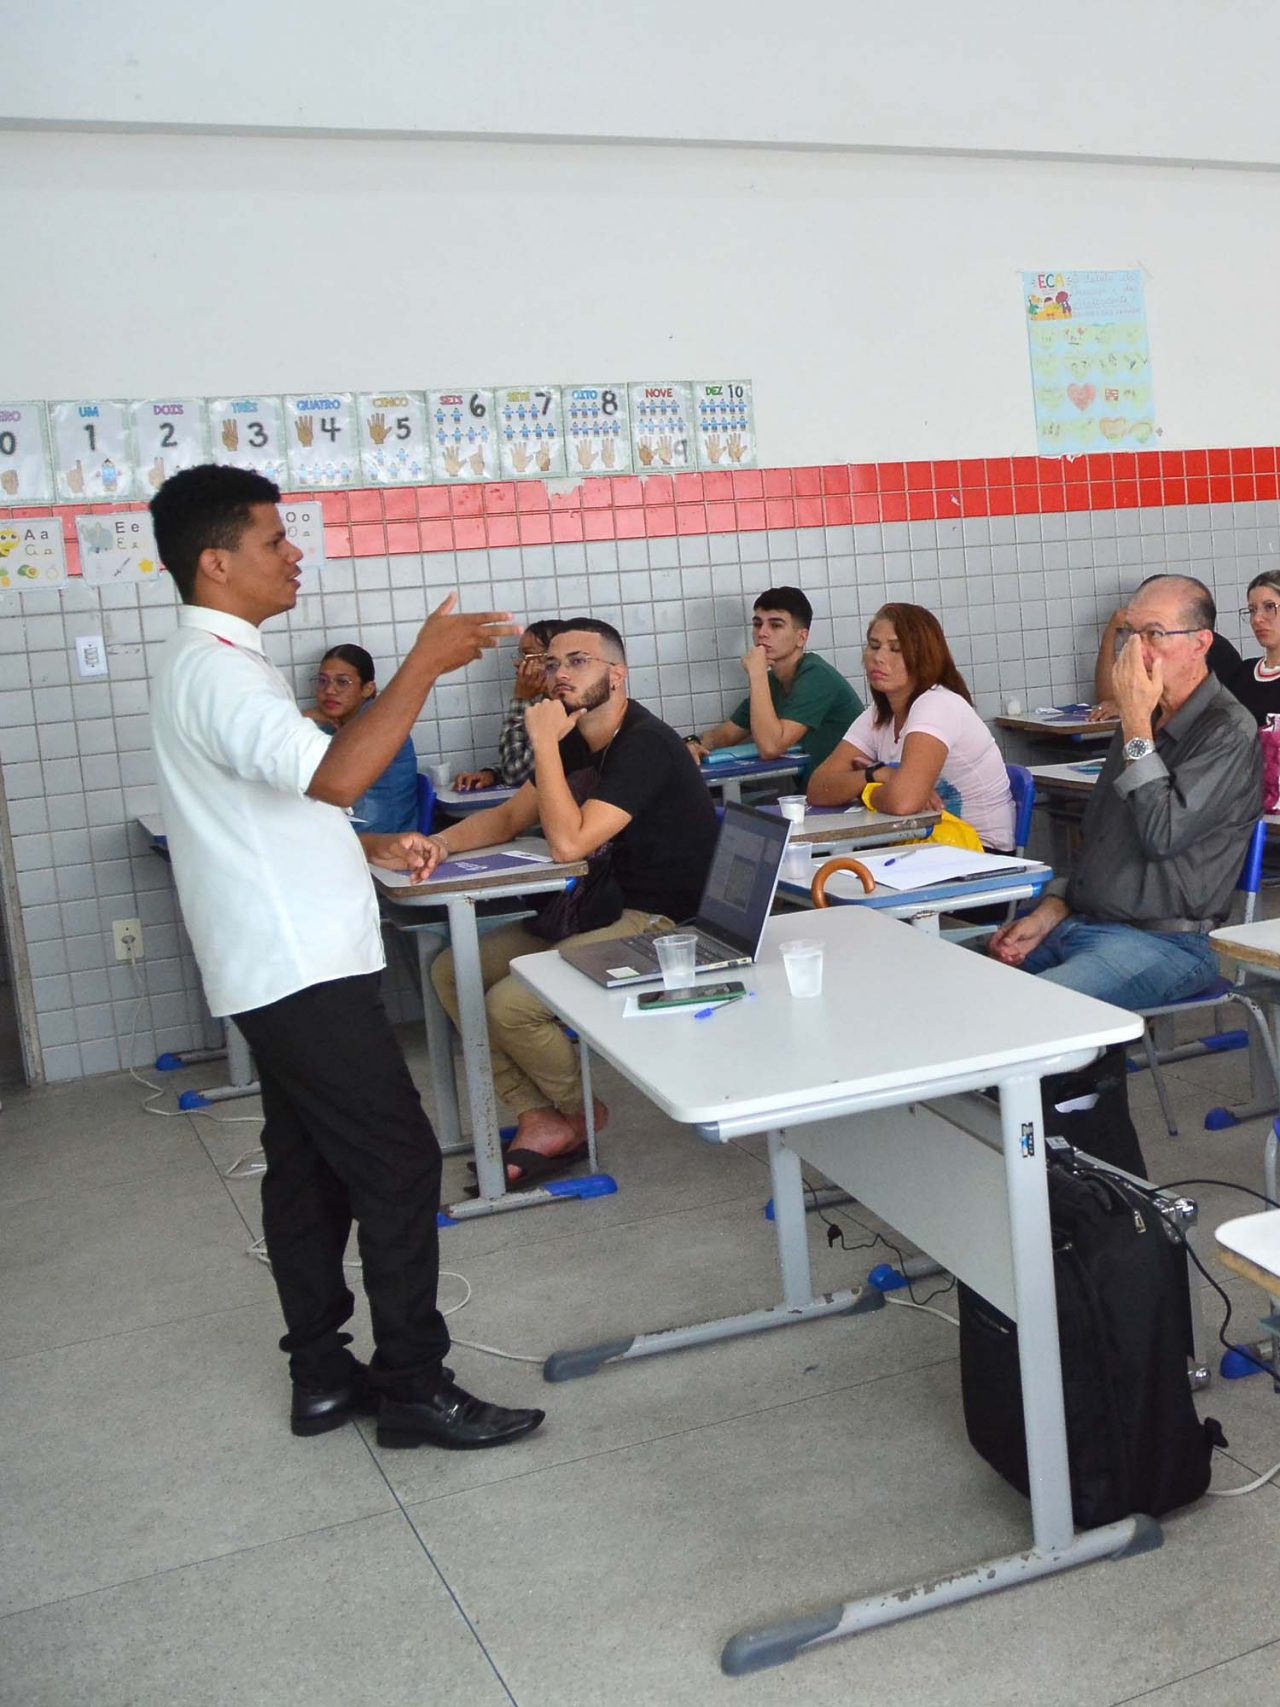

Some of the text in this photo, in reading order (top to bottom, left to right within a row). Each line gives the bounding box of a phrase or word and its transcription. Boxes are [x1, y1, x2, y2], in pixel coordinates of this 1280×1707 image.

[1038, 273, 1065, 289] ECA
[645, 388, 673, 398] NOVE
[705, 384, 744, 398] DEZ 10
[78, 406, 99, 418] UM
[153, 404, 184, 415] DOIS
[296, 399, 341, 411] QUATRO
[469, 393, 486, 418] 6
[535, 391, 552, 415] 7
[602, 390, 618, 416] 8
[84, 424, 95, 451] 1
[160, 422, 178, 447] 2
[247, 422, 268, 447] 3
[321, 417, 341, 442] 4
[396, 417, 411, 440] 5
[0, 431, 16, 455] 0
[674, 439, 688, 464] 9
[24, 529, 49, 541] A a
[115, 521, 139, 534] E e
